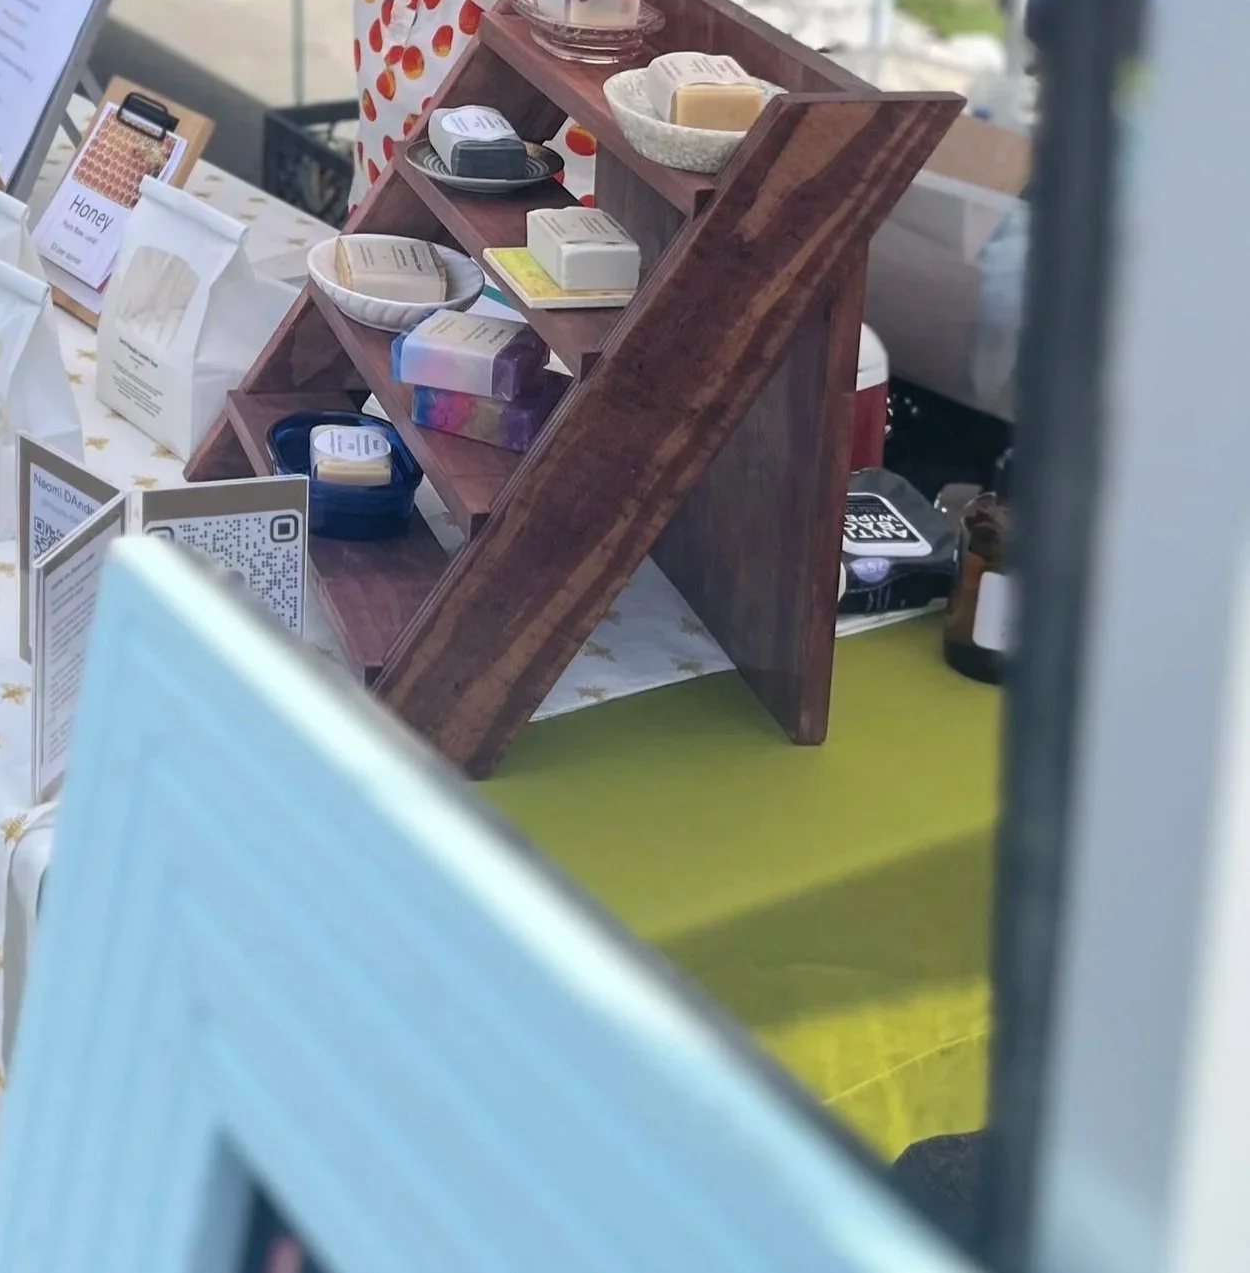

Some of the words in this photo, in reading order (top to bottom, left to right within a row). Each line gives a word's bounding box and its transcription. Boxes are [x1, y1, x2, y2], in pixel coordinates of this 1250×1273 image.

[69, 194, 114, 233] Honey
[33, 472, 62, 499] Naomi
[845, 529, 908, 539] ANTI
